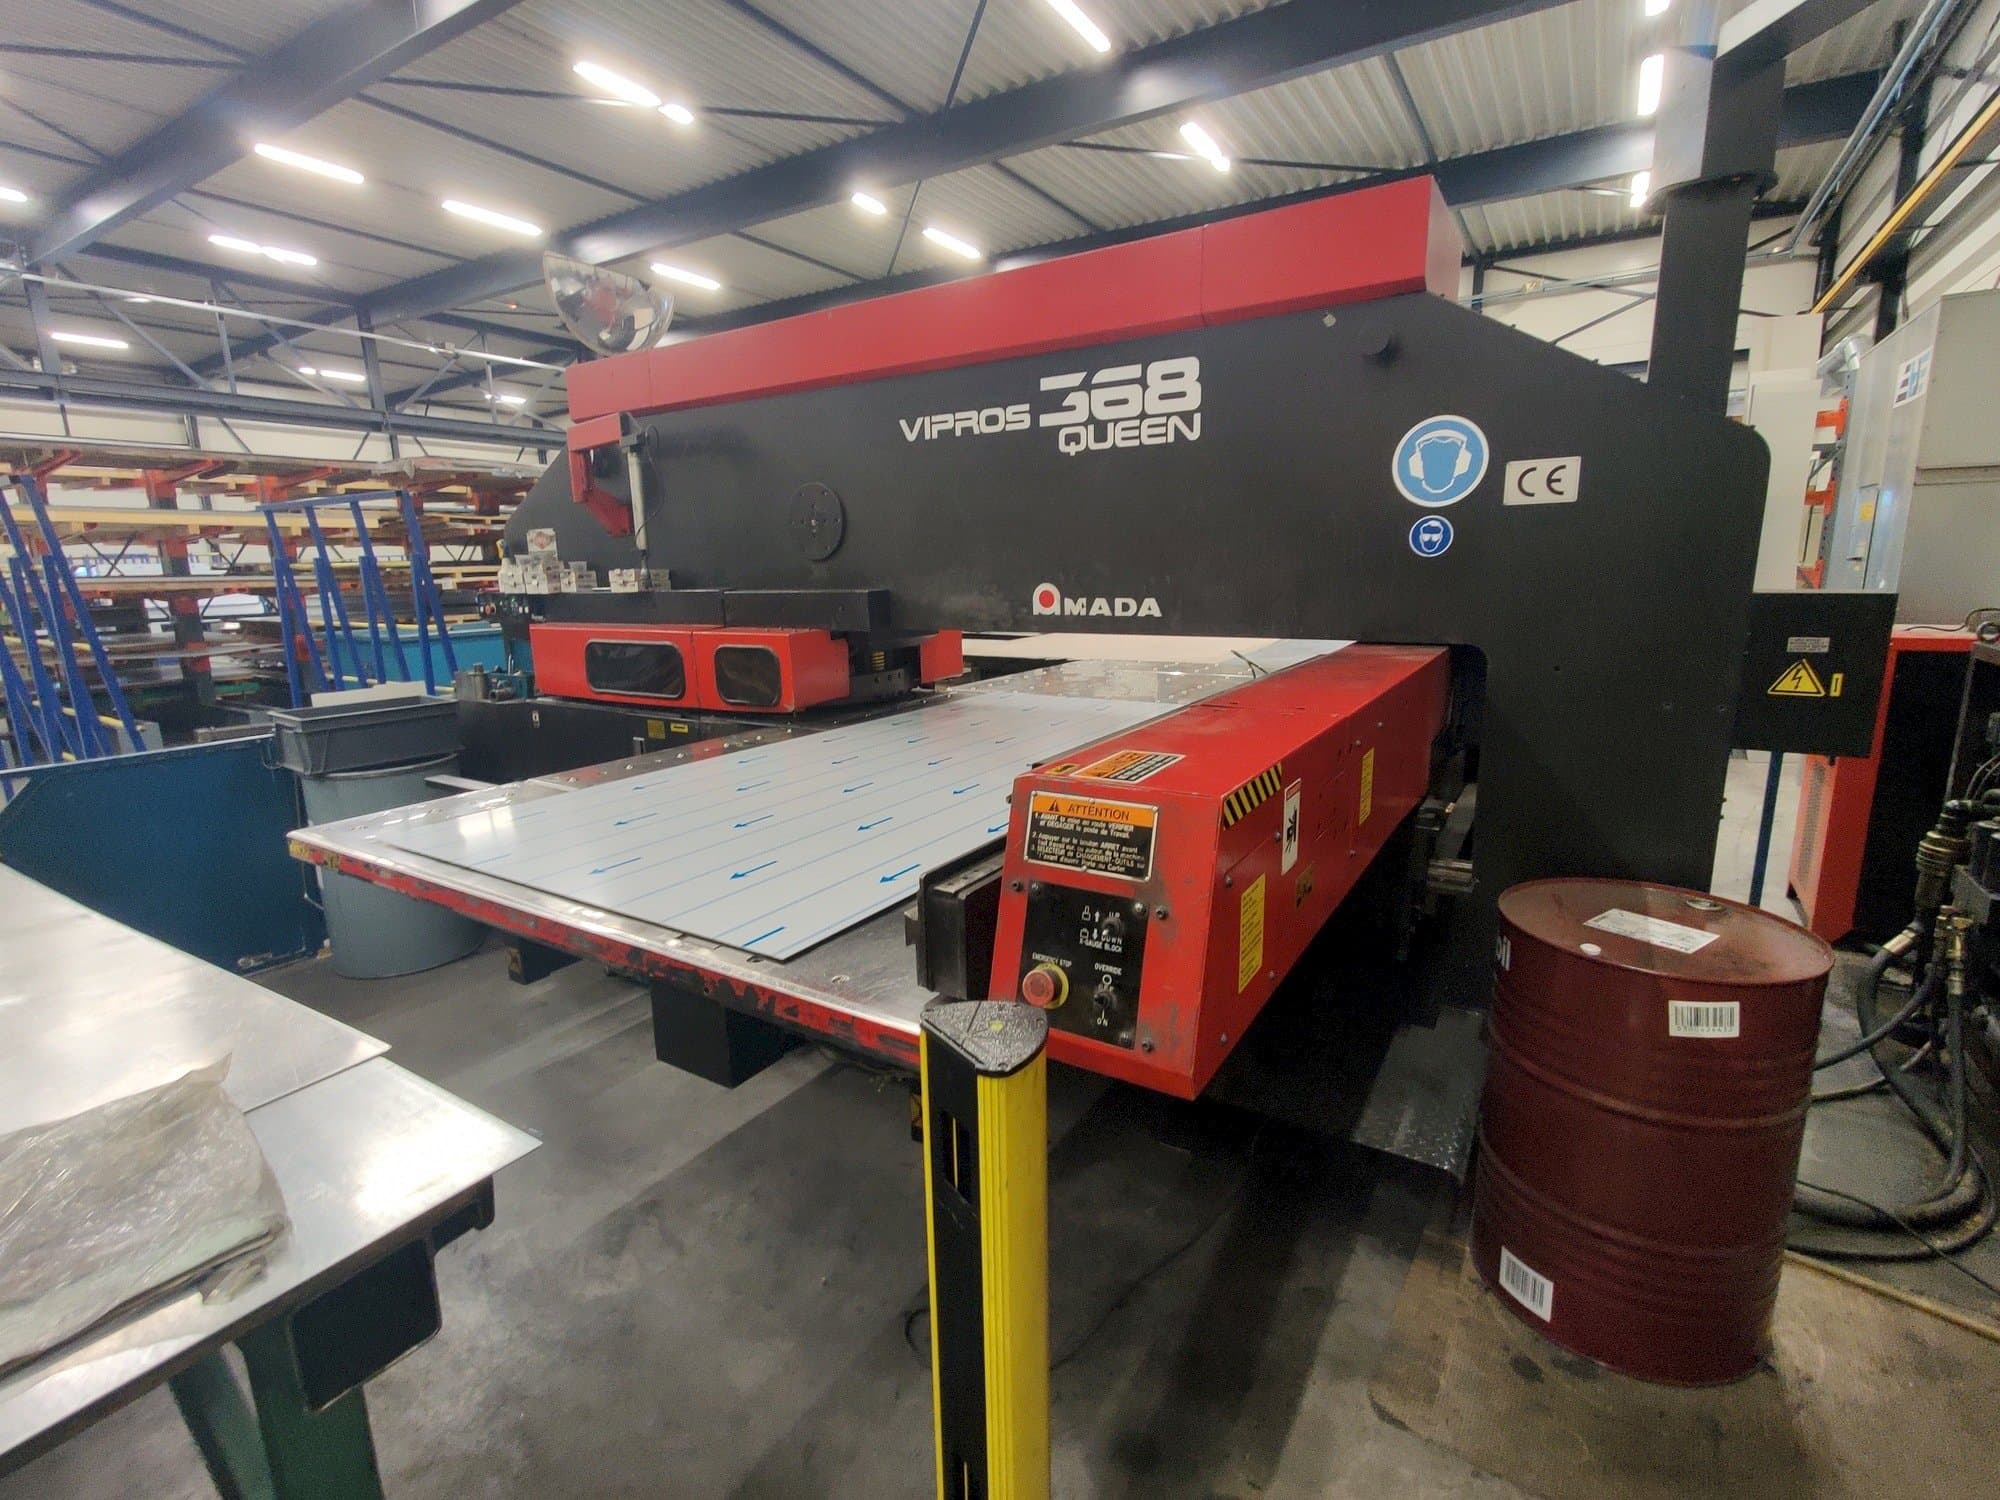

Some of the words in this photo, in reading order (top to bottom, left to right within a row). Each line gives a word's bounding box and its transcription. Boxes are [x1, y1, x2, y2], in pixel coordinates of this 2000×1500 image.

[899, 403, 1031, 442] VIPROS
[1039, 356, 1201, 427] 368
[1058, 412, 1201, 456] QUEEN
[1518, 465, 1567, 497] CE
[1032, 582, 1162, 617] AMADA
[1068, 803, 1130, 821] ATTENTION
